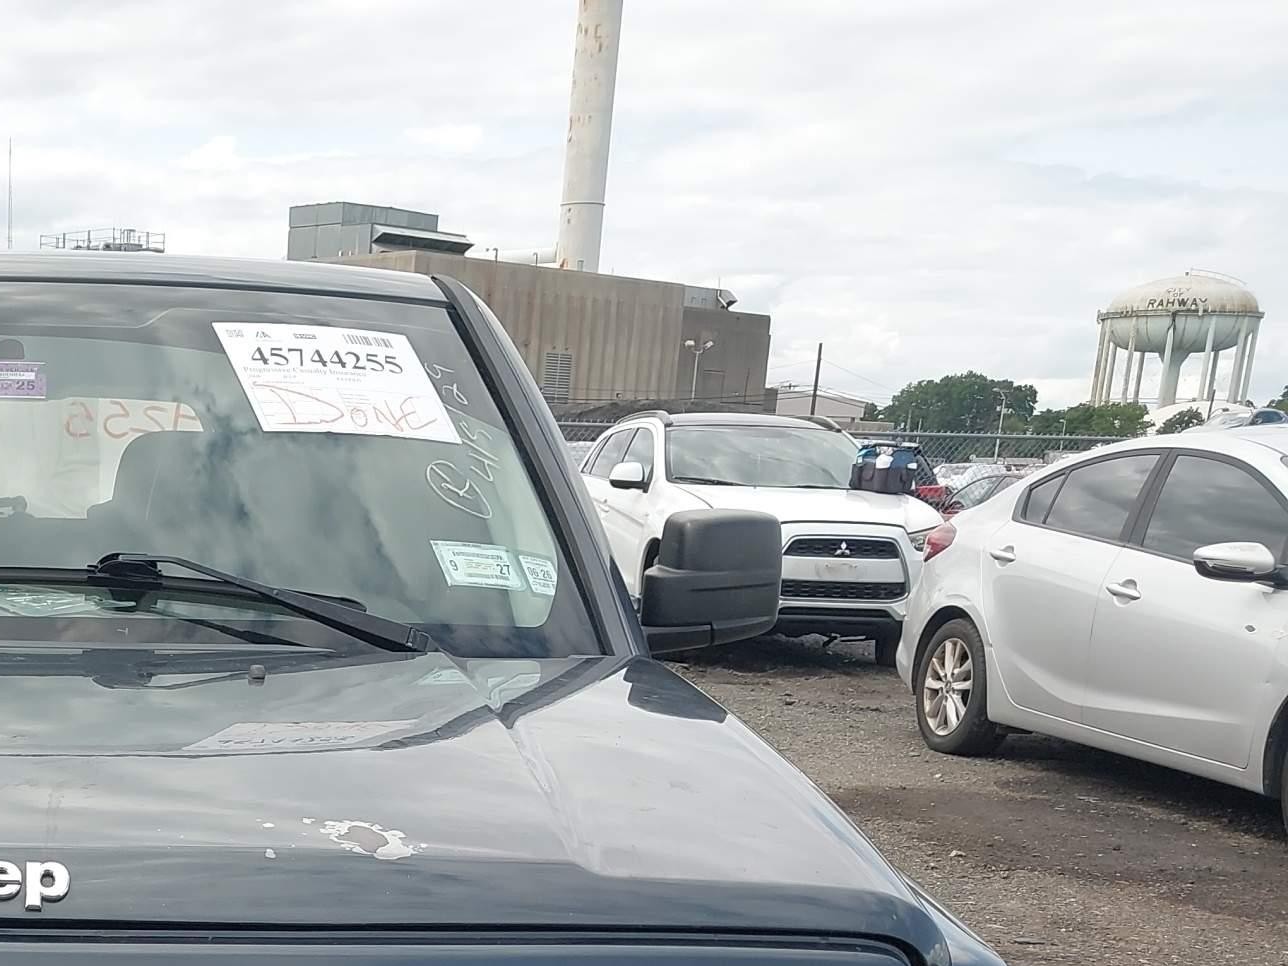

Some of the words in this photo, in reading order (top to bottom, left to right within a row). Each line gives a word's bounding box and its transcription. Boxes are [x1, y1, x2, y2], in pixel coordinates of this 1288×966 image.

[1146, 297, 1208, 309] RAHWAY
[250, 345, 404, 375] 45744255
[15, 380, 36, 391] 25
[448, 559, 459, 572] 9
[495, 563, 511, 576] 27
